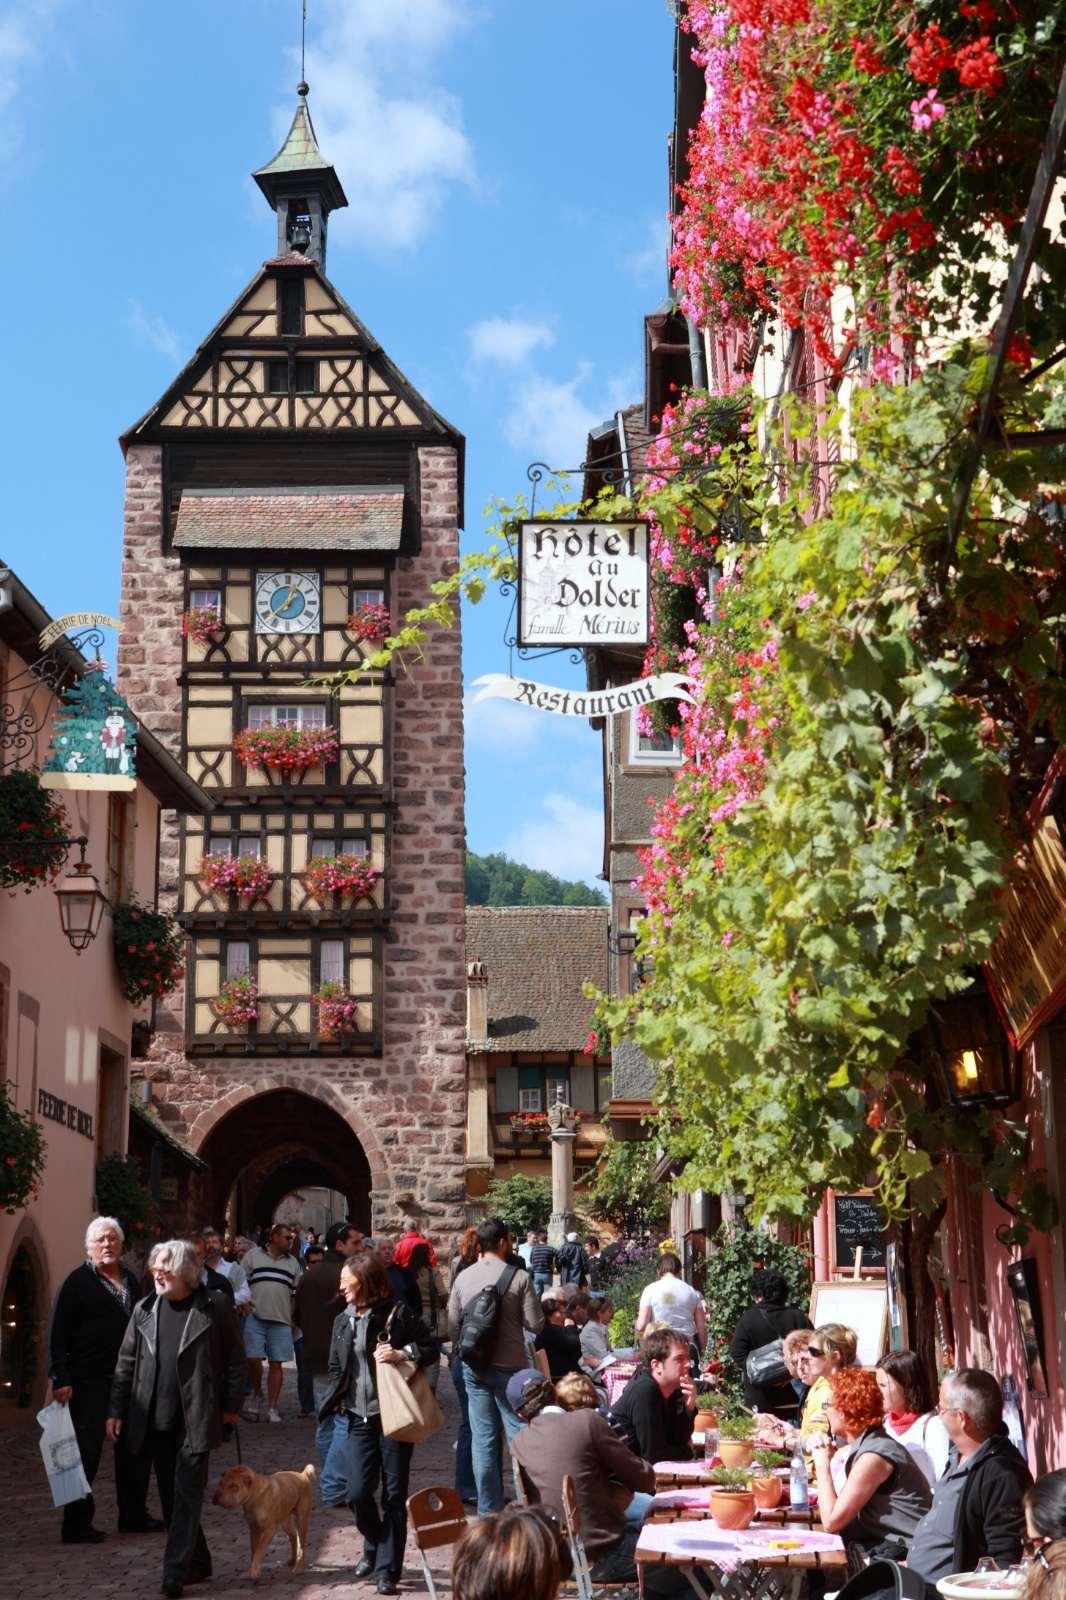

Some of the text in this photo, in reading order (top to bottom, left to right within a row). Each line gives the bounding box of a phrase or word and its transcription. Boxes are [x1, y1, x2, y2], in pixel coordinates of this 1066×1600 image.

[531, 525, 639, 560] Hôtel
[553, 577, 641, 608] Dolder
[47, 614, 112, 638] FEERIE DE NOEL
[523, 613, 640, 640] famille Mérius
[514, 680, 657, 716] Restaurant
